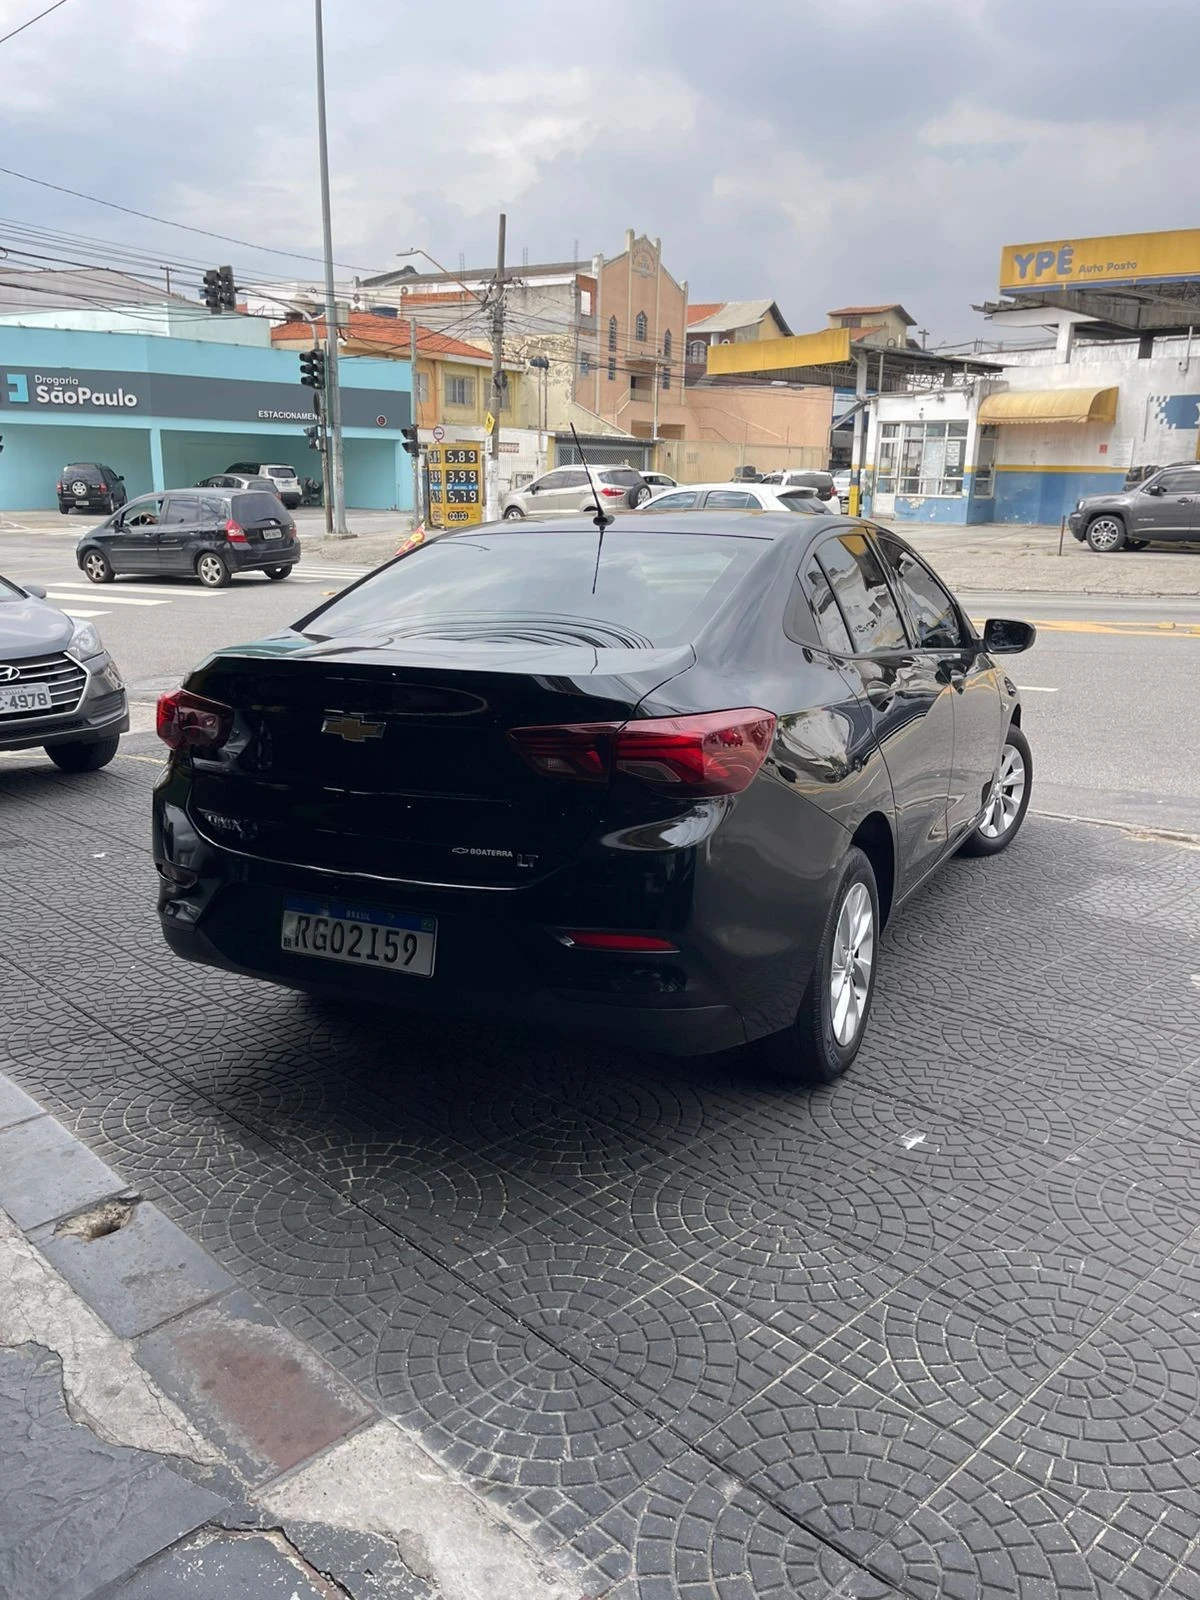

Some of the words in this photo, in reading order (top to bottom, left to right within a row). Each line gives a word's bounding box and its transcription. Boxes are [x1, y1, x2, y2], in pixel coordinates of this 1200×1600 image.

[1014, 244, 1074, 279] YPÊ
[1079, 264, 1103, 274] Auto
[1106, 261, 1137, 272] Posto
[34, 374, 79, 386] Drogaria
[36, 385, 138, 407] SãoPaulo
[258, 410, 320, 421] ESTACIONAMEN
[470, 848, 513, 858] BOATERRA
[516, 853, 539, 868] LT
